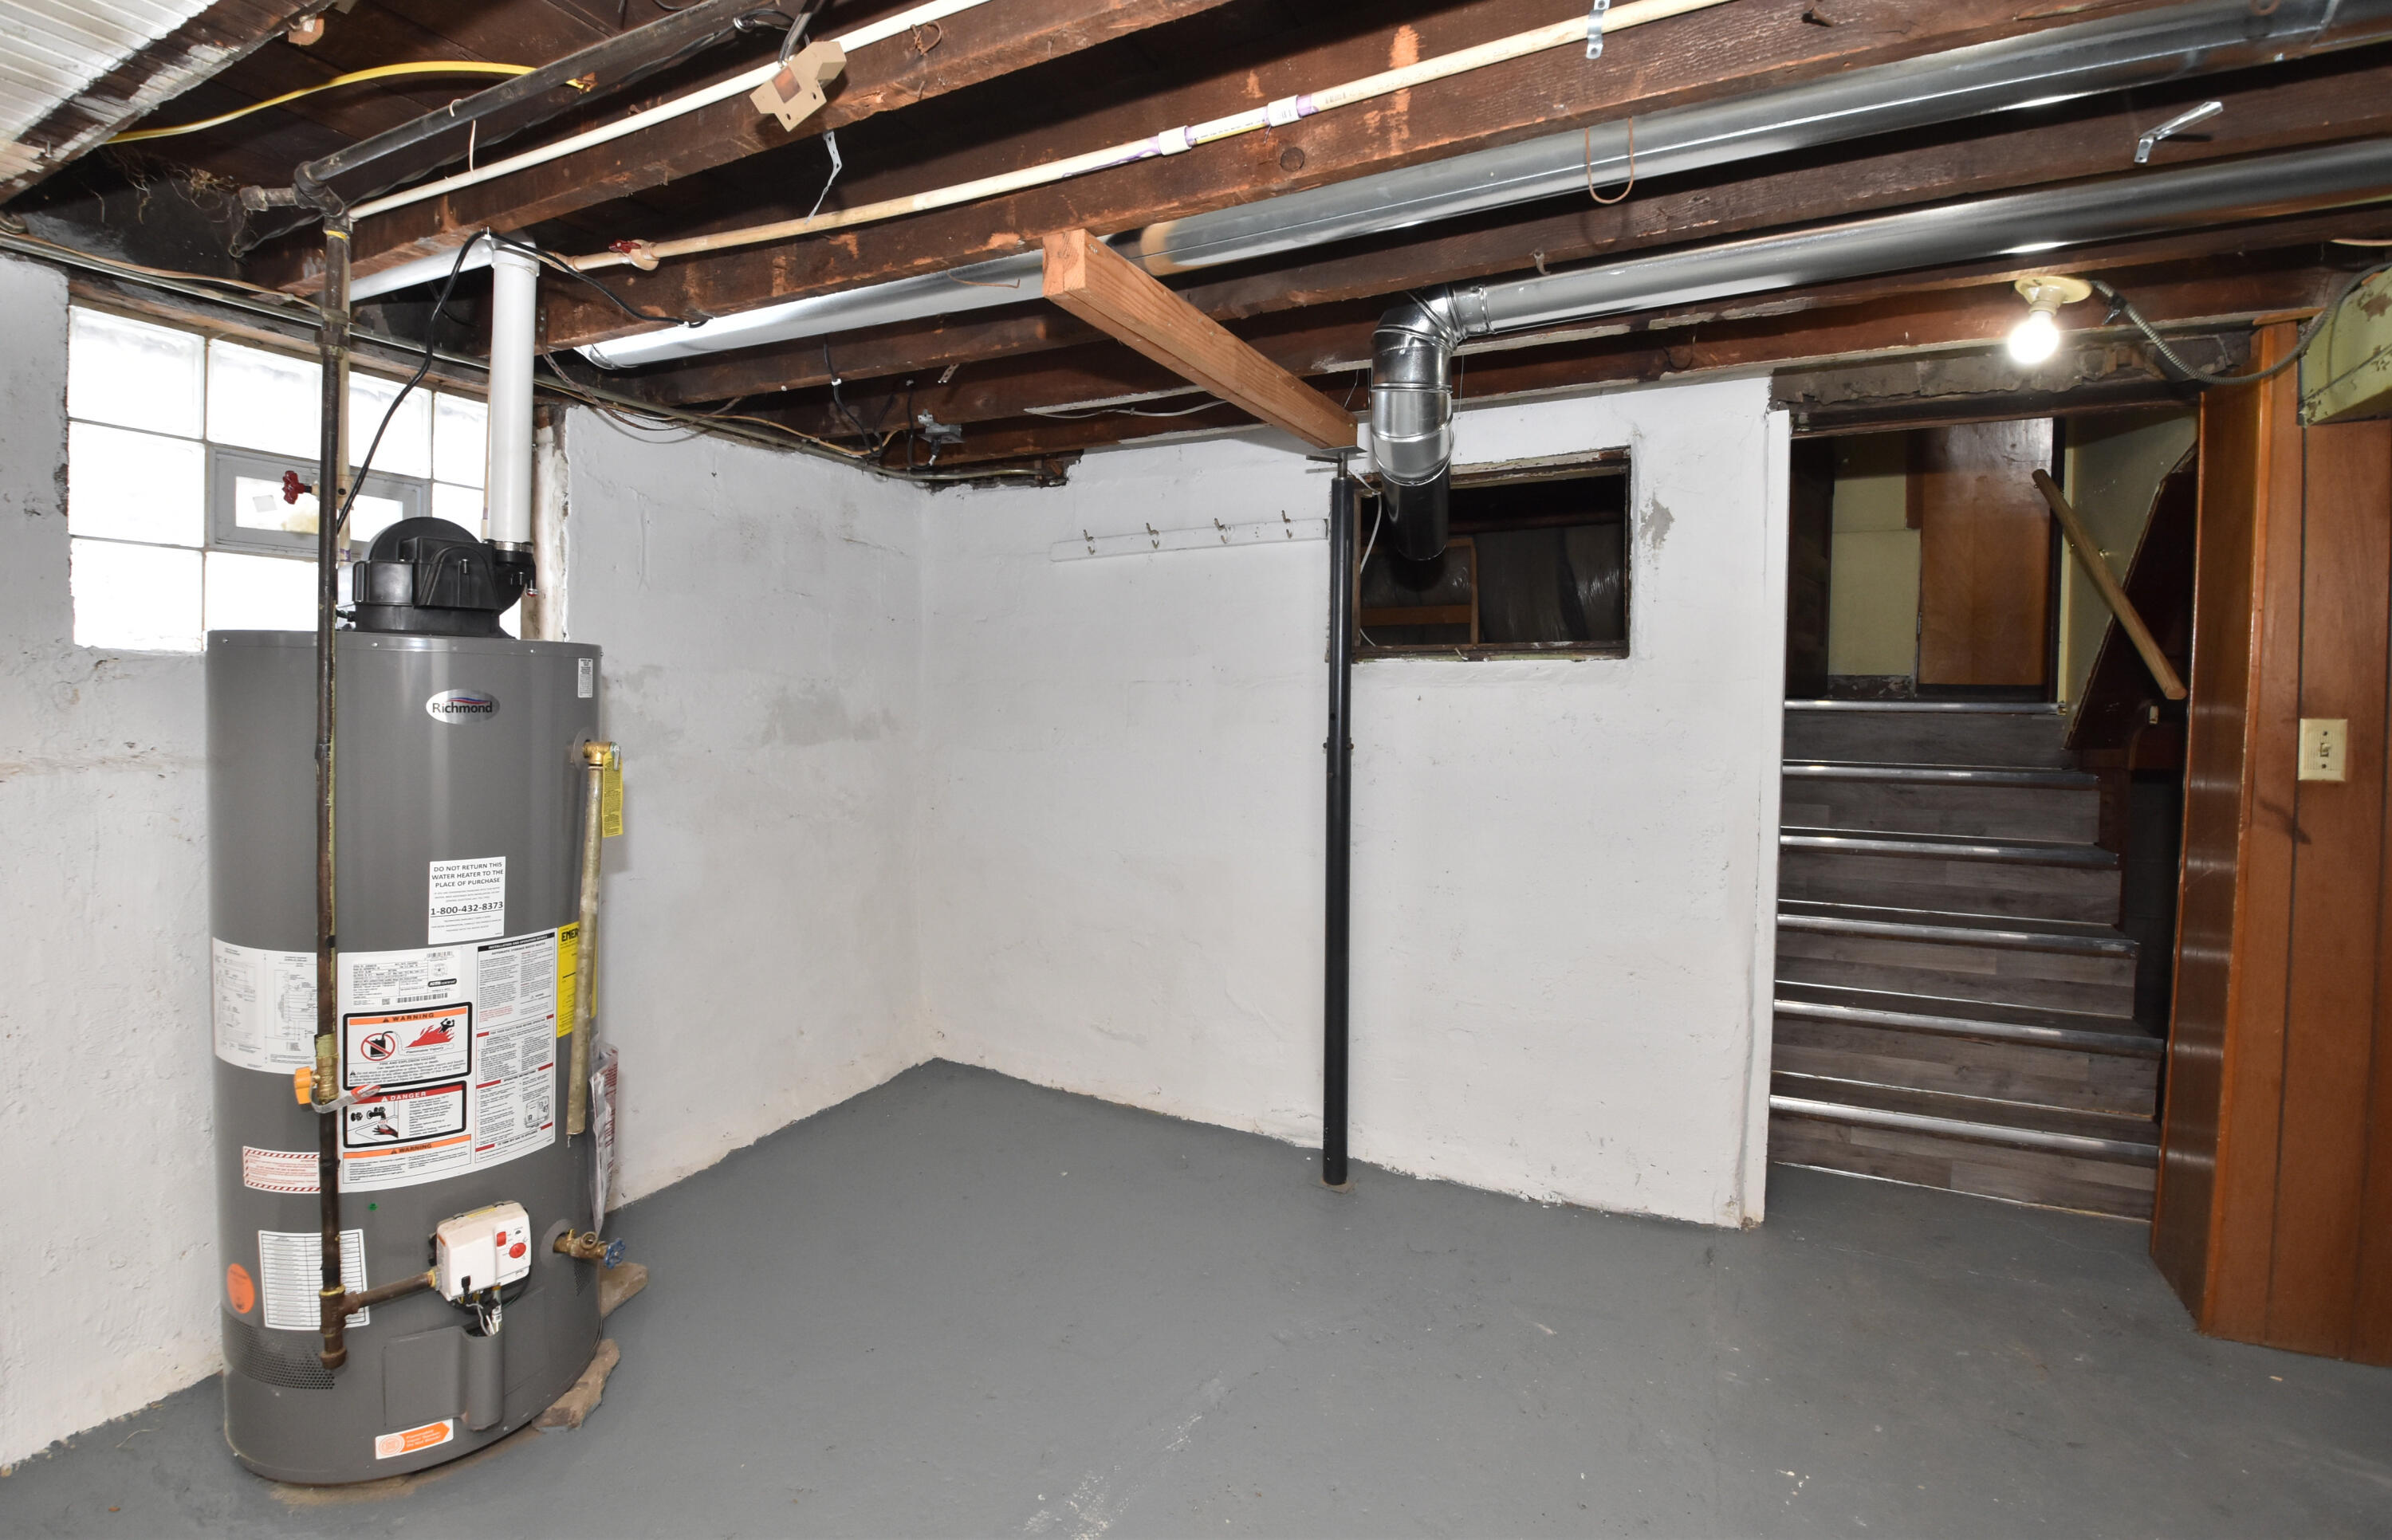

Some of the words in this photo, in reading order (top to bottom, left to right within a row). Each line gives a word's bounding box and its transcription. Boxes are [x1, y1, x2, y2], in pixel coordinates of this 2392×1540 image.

[432, 701, 493, 713] Richmond
[431, 901, 503, 915] 1-800-432-8373
[392, 1012, 435, 1021] WARNING
[391, 1091, 427, 1101] DANGER
[399, 1143, 432, 1153] WARNING
